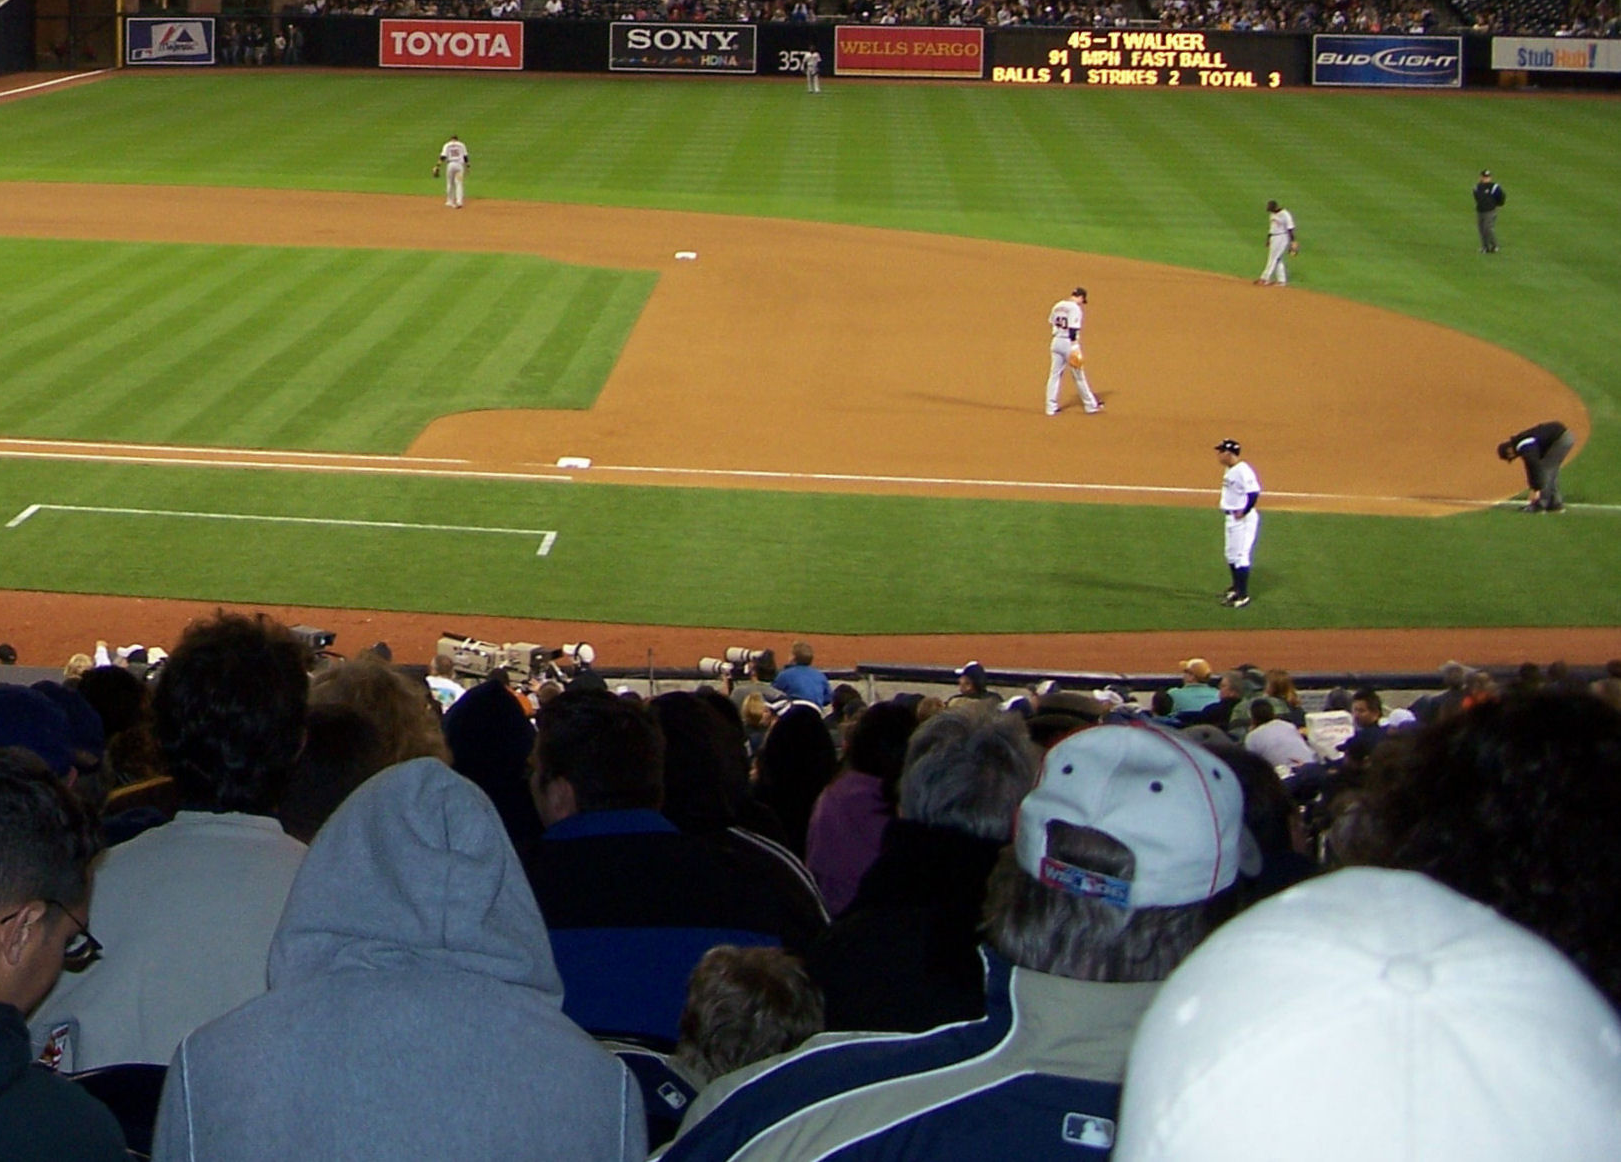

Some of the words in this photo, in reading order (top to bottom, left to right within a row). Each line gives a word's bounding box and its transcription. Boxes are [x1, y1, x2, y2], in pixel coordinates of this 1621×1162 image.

[390, 30, 512, 58] TOYOTA
[627, 29, 735, 51] SONY
[840, 40, 908, 57] WELLS
[911, 41, 980, 58] FARGO
[699, 54, 739, 68] HDNA
[1047, 50, 1068, 66] 91
[1080, 51, 1121, 67] MPH
[1315, 52, 1372, 66] BUD
[1383, 54, 1459, 68] LIGHT
[1517, 42, 1598, 69] StubHub!
[992, 67, 1051, 84] BALLS
[1061, 68, 1073, 85] 1
[1087, 69, 1159, 86] STRIKES
[1167, 70, 1180, 87] 2
[1199, 71, 1258, 87] TOTAL
[1268, 71, 1281, 88] 3
